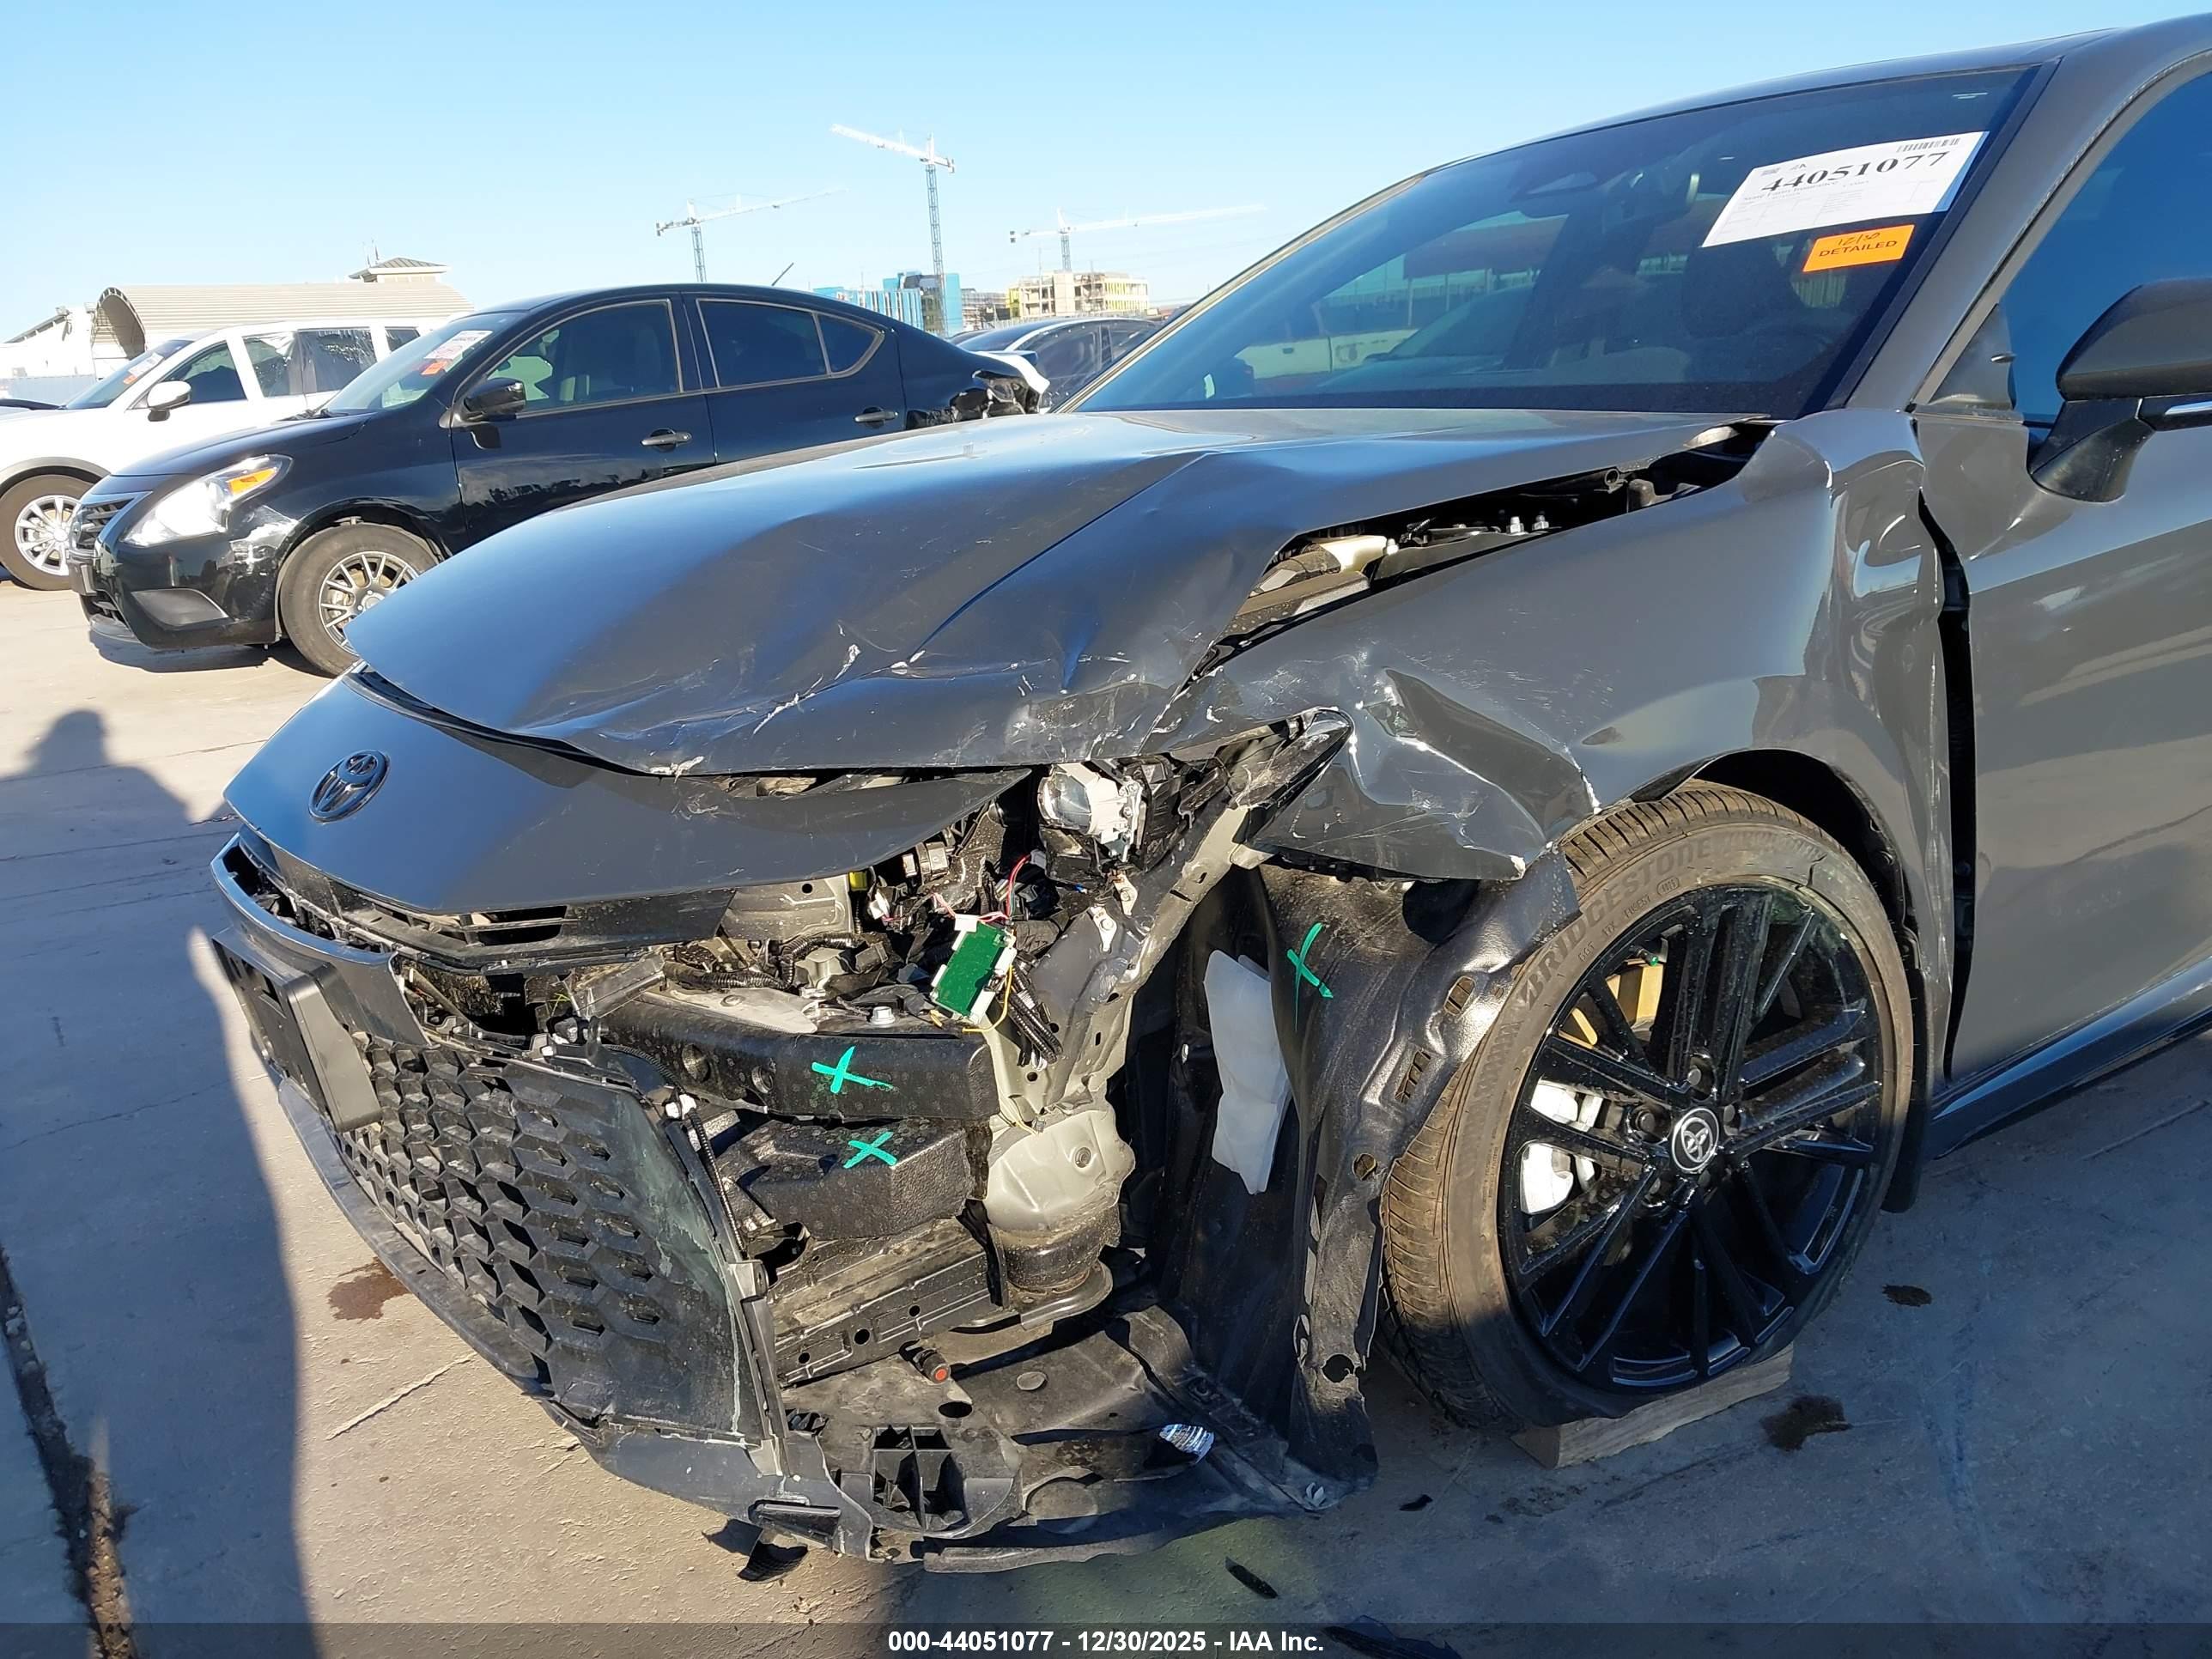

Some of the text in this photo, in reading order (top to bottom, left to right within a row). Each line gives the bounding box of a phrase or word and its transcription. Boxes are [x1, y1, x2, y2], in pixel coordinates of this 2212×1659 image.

[1760, 150, 1950, 191] 44051077
[1819, 240, 1898, 258] DETAILED
[1521, 838, 1711, 1011] BRIDGESTONE
